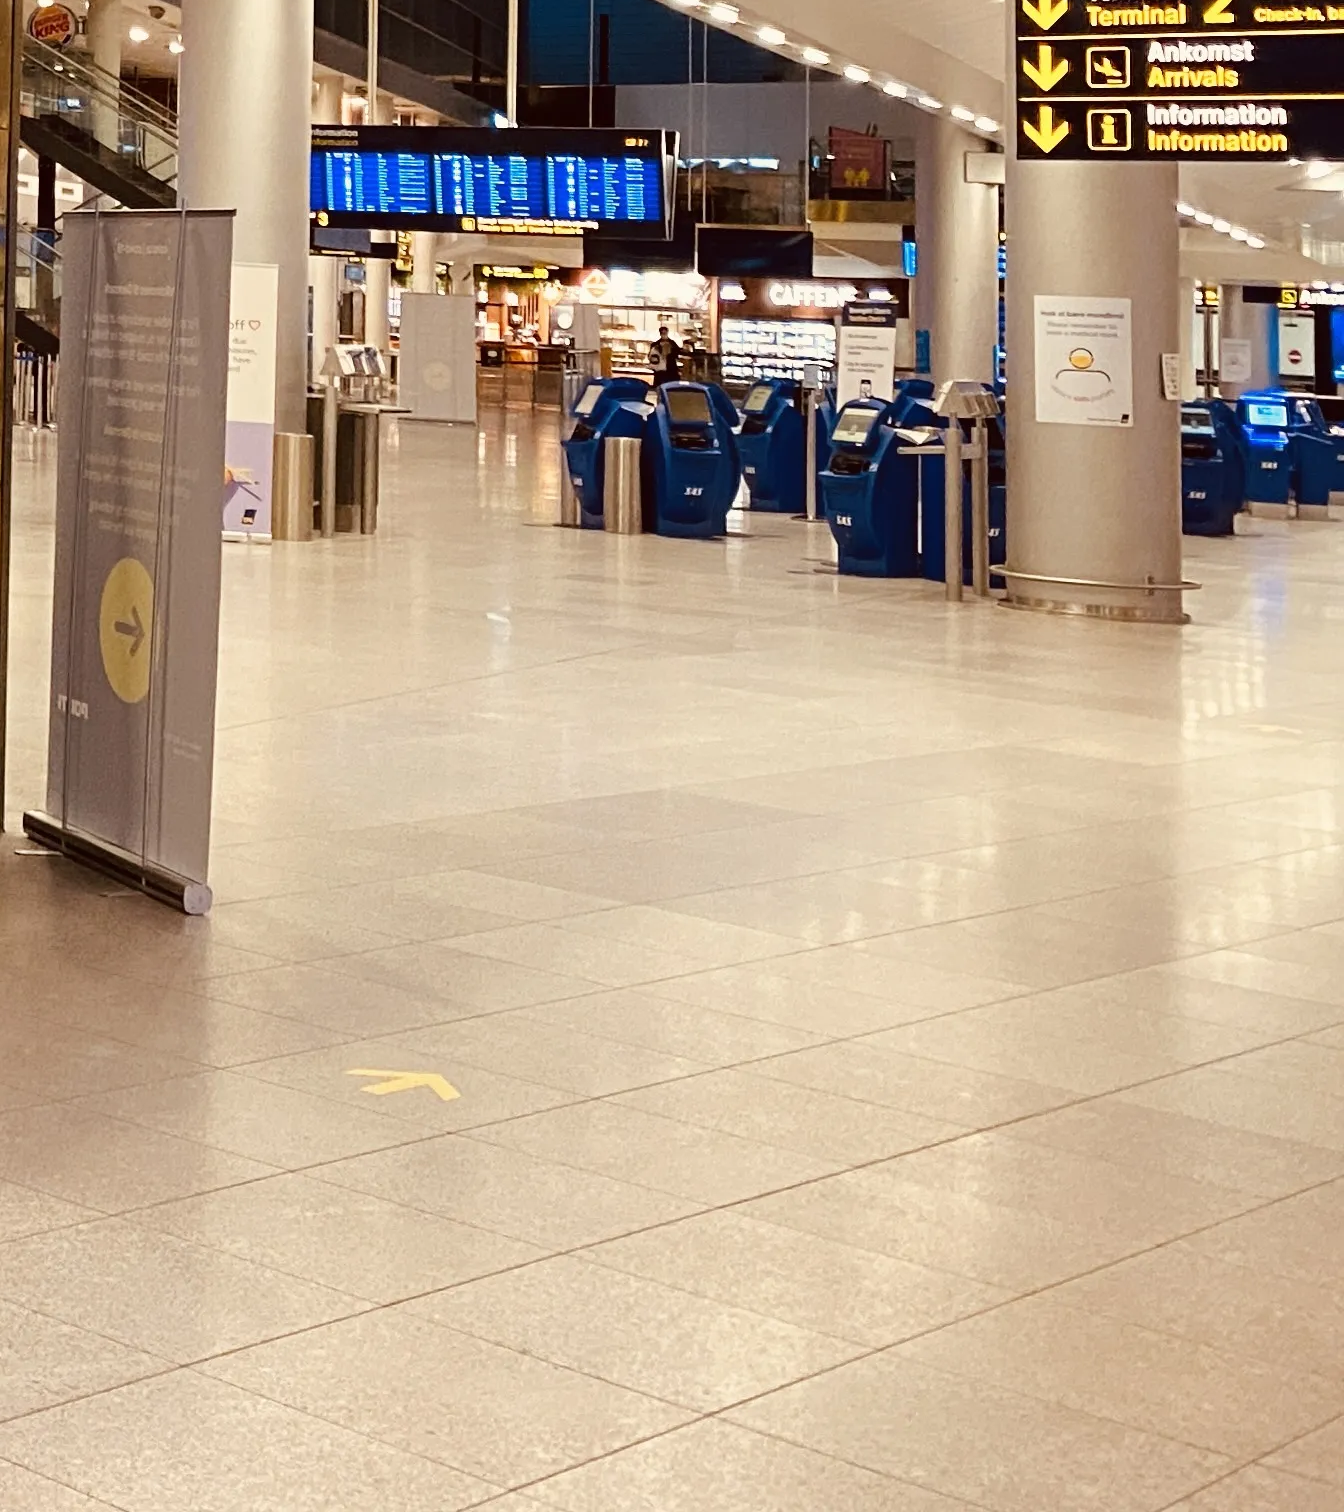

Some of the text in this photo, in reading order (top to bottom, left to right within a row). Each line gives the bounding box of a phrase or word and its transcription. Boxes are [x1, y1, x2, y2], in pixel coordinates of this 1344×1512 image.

[1085, 3, 1187, 27] Terminal
[1147, 39, 1256, 64] Ankomst
[1147, 65, 1240, 88] Arrivals
[1146, 103, 1289, 126] Information
[1147, 129, 1289, 152] Information
